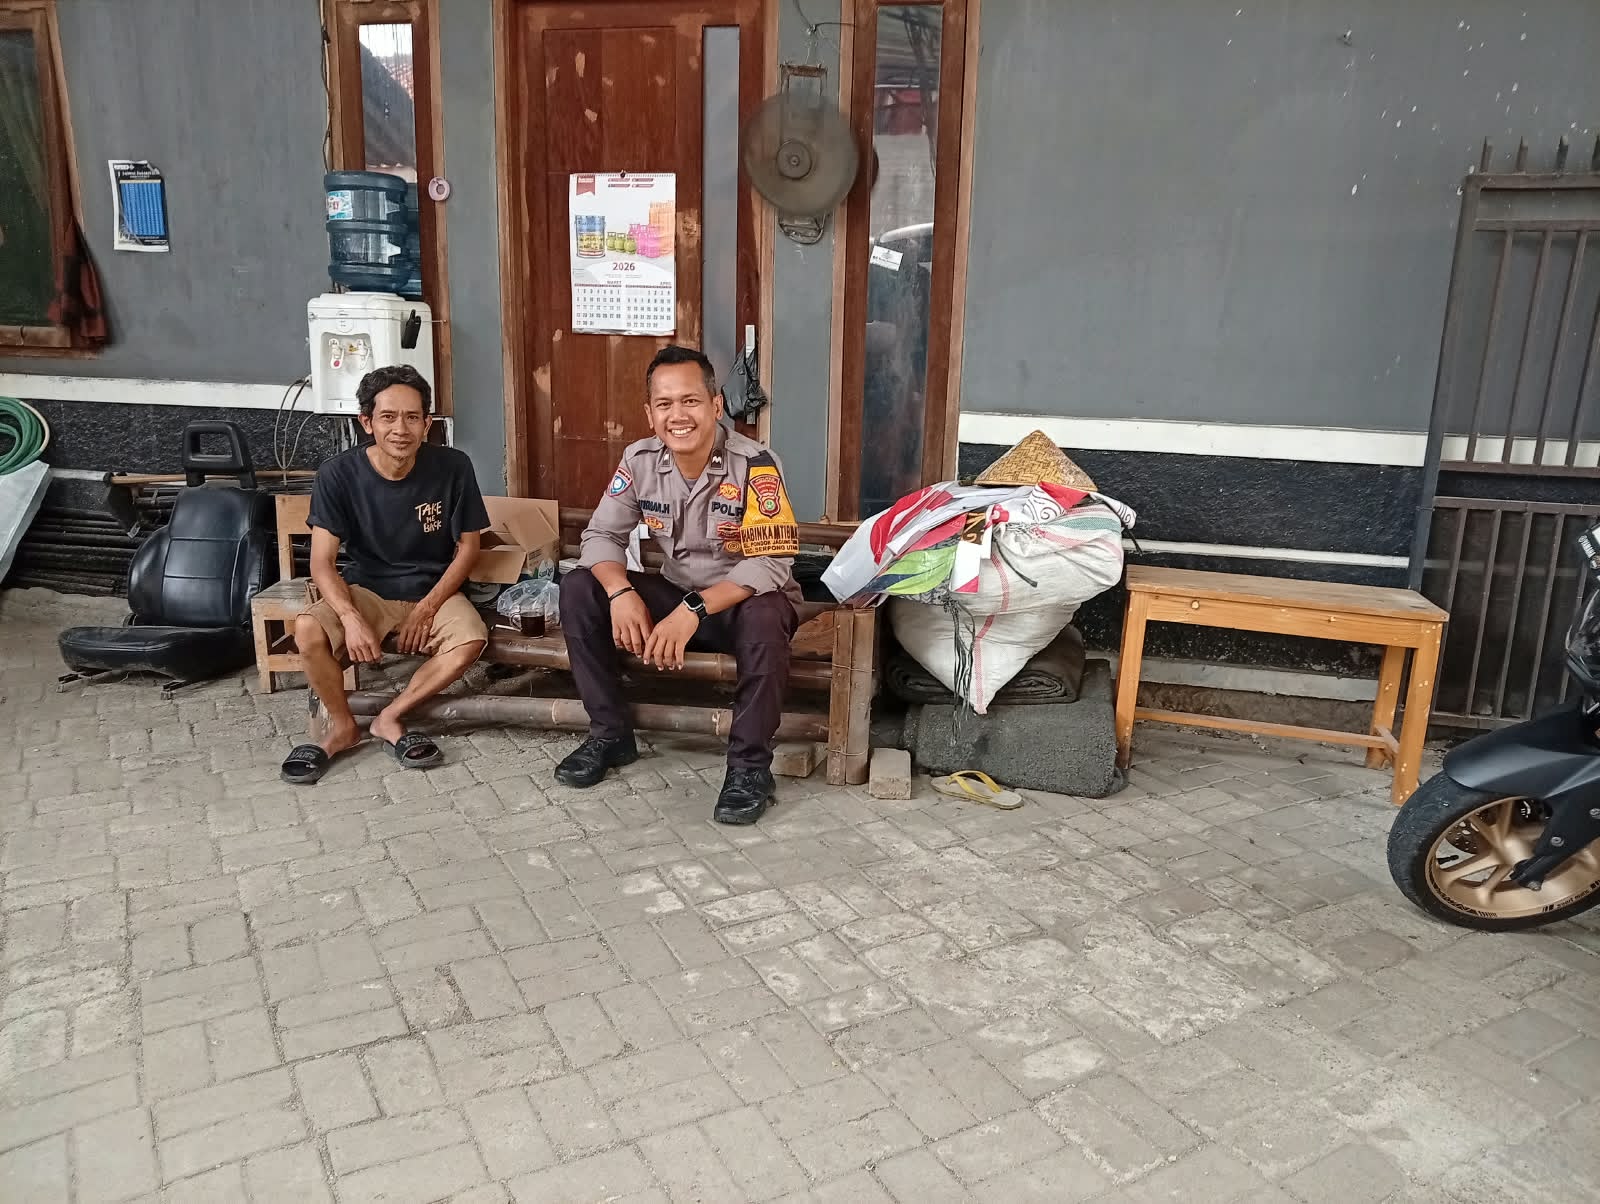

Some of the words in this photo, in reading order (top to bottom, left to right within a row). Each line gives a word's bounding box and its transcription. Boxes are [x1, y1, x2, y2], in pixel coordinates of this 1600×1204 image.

[613, 262, 635, 271] 2026
[414, 500, 442, 522] TAKE
[426, 515, 435, 523] ME
[423, 520, 442, 532] BACK
